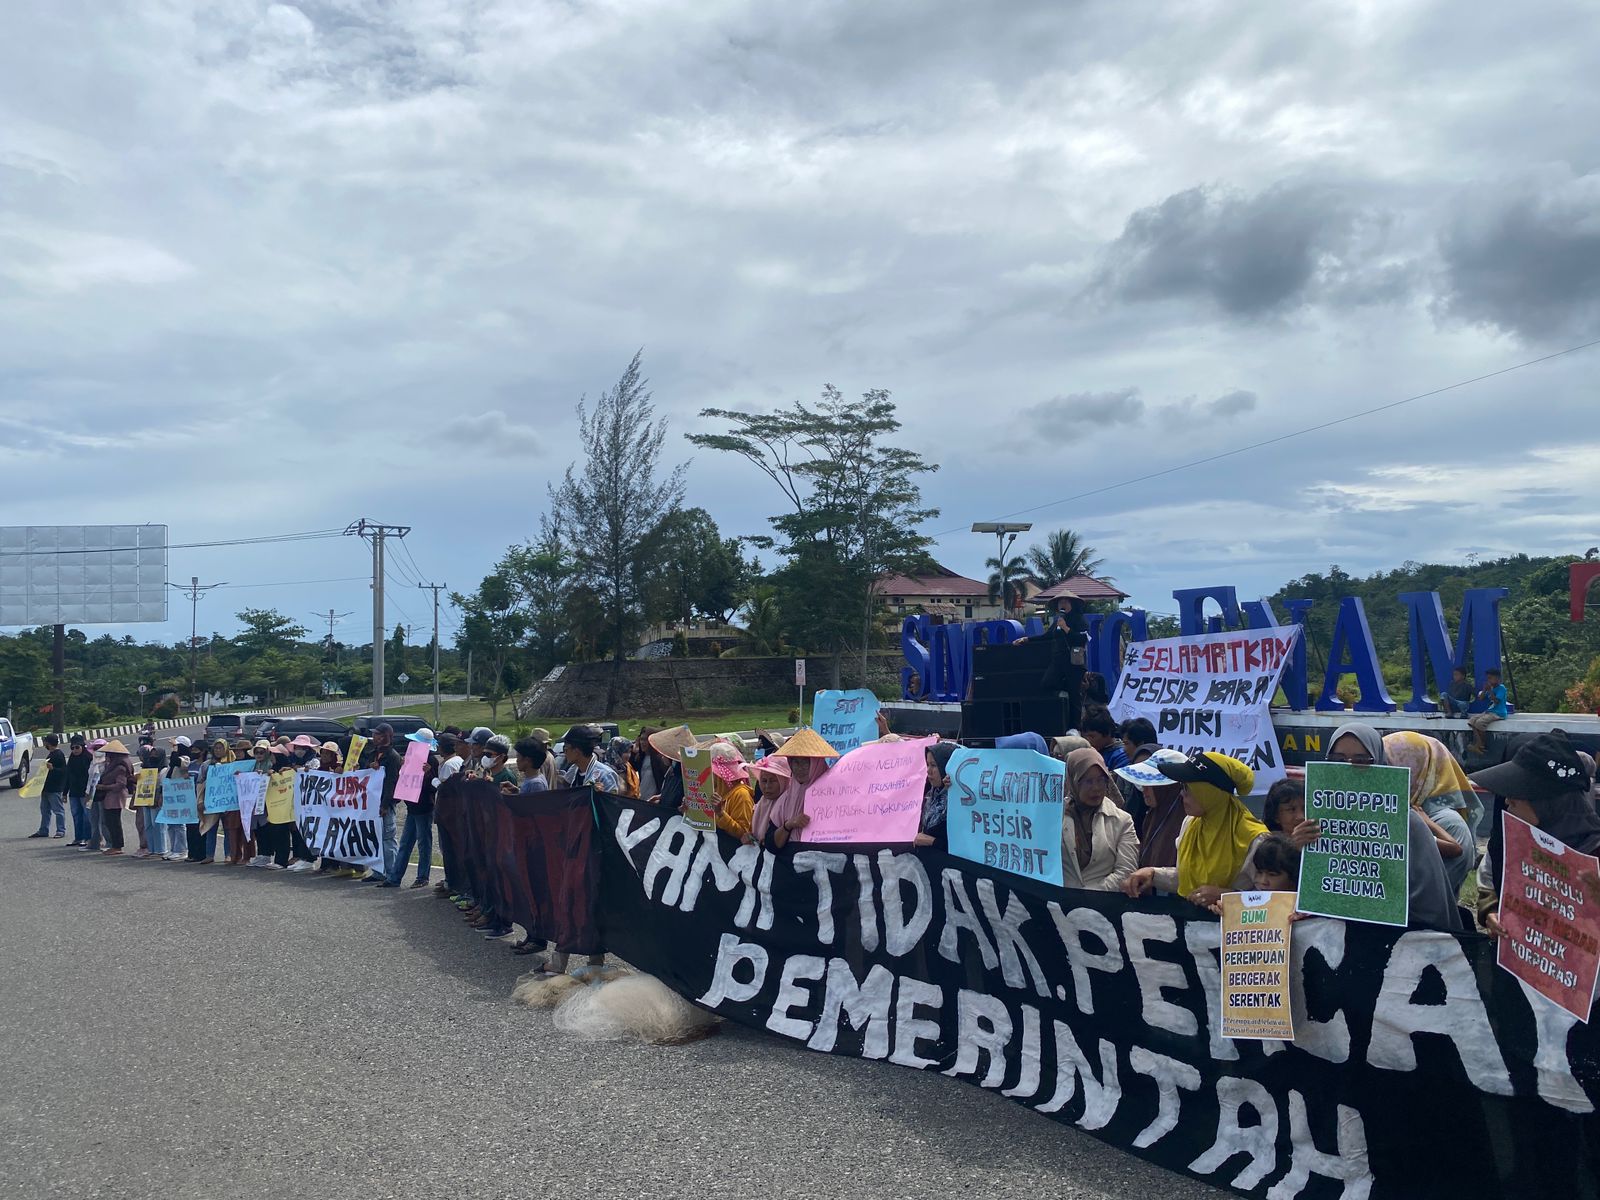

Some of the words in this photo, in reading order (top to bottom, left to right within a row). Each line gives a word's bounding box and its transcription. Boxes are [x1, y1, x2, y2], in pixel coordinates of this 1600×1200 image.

[1124, 637, 1291, 673] #SELAMATKAN
[1120, 673, 1199, 705] PESISIR
[1202, 675, 1274, 705] BARA
[1158, 708, 1221, 737] DARI
[330, 774, 370, 810] HAM
[1313, 790, 1398, 813] STOPPP!!
[1319, 818, 1390, 839] PERKOSA
[985, 841, 1048, 874] BARAT
[1306, 838, 1404, 860] LINGKUNGAN
[614, 808, 776, 930] KAMI
[1329, 858, 1379, 877] PASAR
[1322, 877, 1385, 899] SELUMA
[1521, 860, 1584, 905] BENGKULU
[1241, 909, 1267, 924] BUMI
[1525, 885, 1576, 922] DILEPAS
[1225, 929, 1285, 946] BERTERIAK,
[1525, 926, 1567, 961] UNTUK
[1224, 950, 1285, 966] PEREMPUAN
[1228, 971, 1281, 987] BERGERAK
[1229, 992, 1282, 1008] SERENTAK
[694, 932, 1375, 1200] PEMERINTAH
